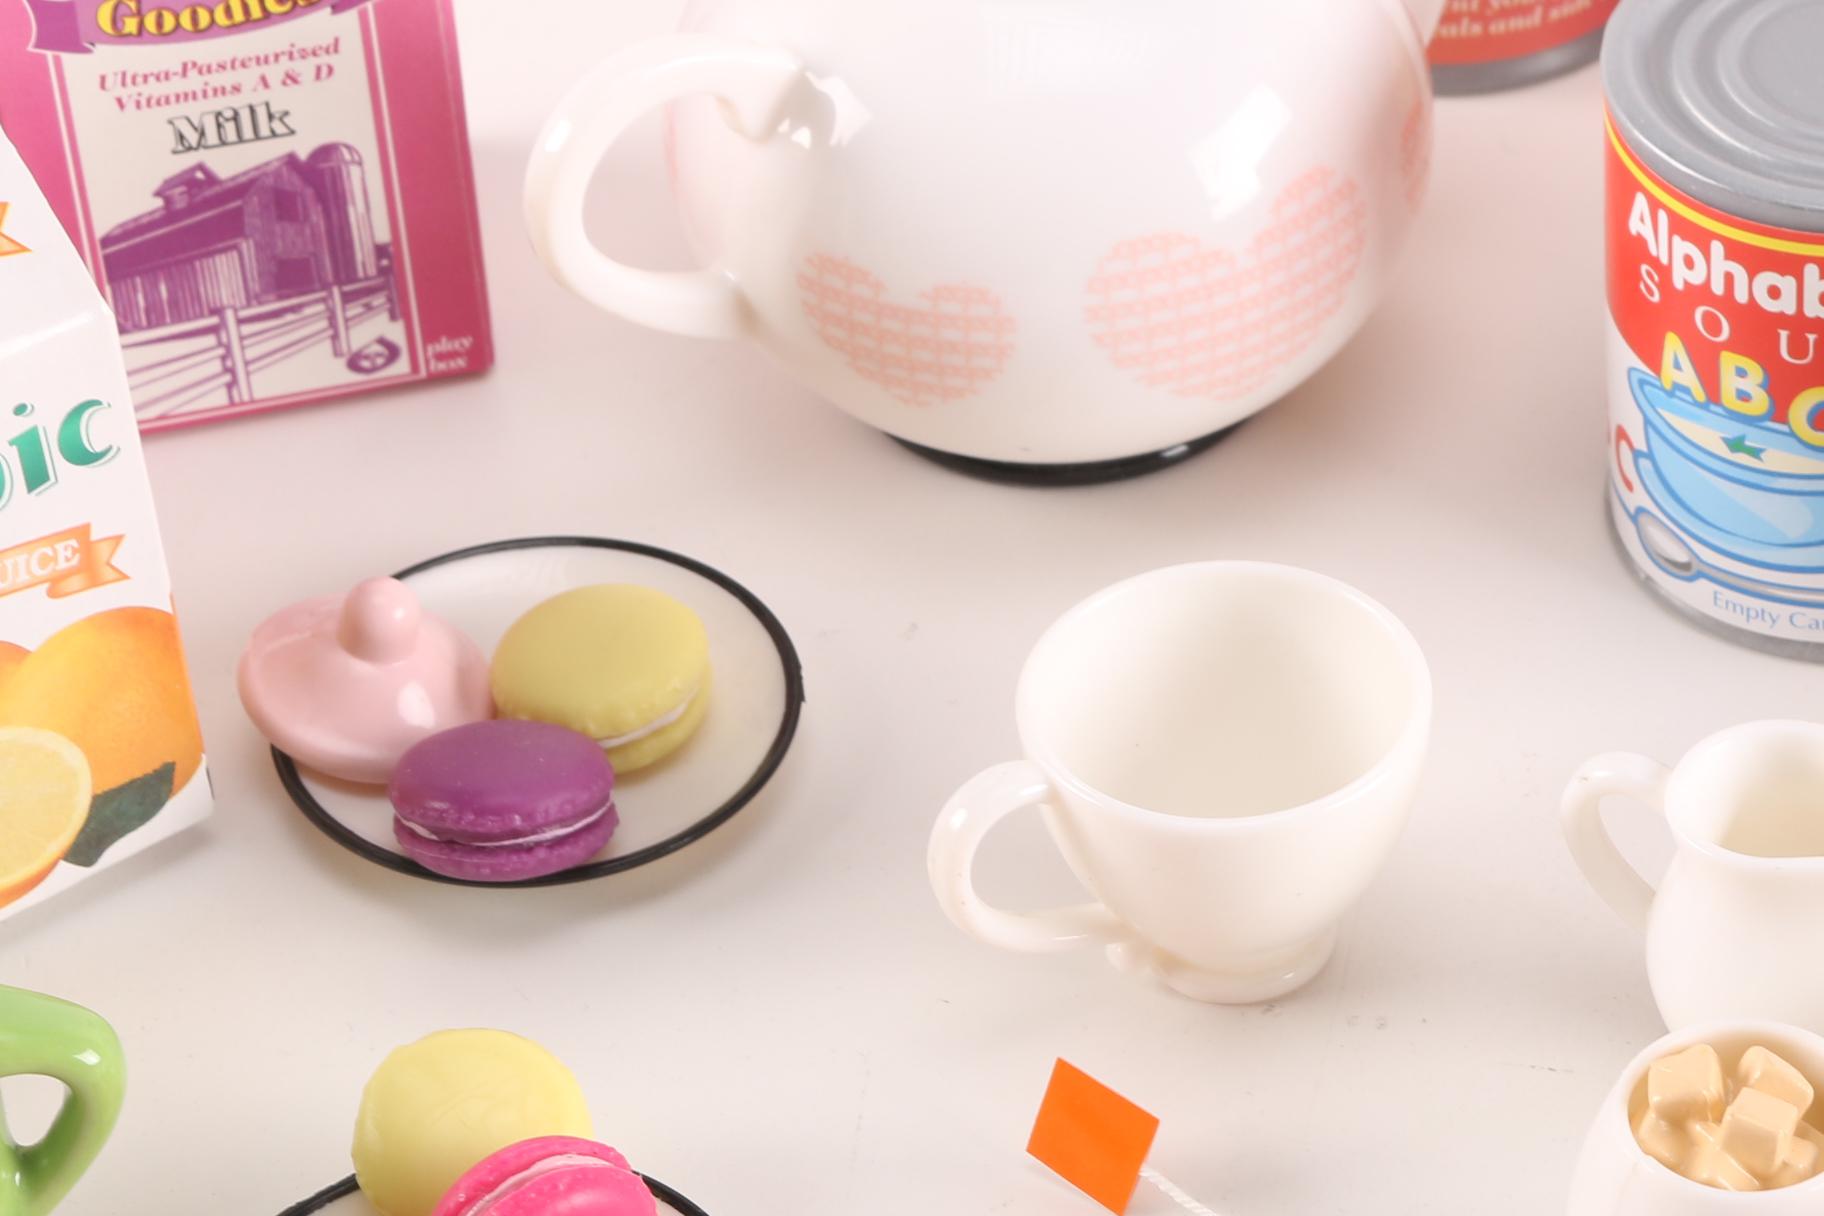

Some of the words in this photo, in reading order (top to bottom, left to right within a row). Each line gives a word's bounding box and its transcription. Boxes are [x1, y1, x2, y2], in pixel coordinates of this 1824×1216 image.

[96, 0, 322, 37] Goodie
[98, 37, 341, 92] Ultra-Pasteurized
[114, 80, 242, 112] Vitamins
[251, 73, 271, 92] A
[281, 68, 302, 88] &
[313, 62, 335, 83] D
[166, 100, 297, 155] Milk
[427, 334, 474, 360] play
[430, 355, 468, 373] box
[0, 538, 81, 588] UICE
[1713, 589, 1780, 630] Empty
